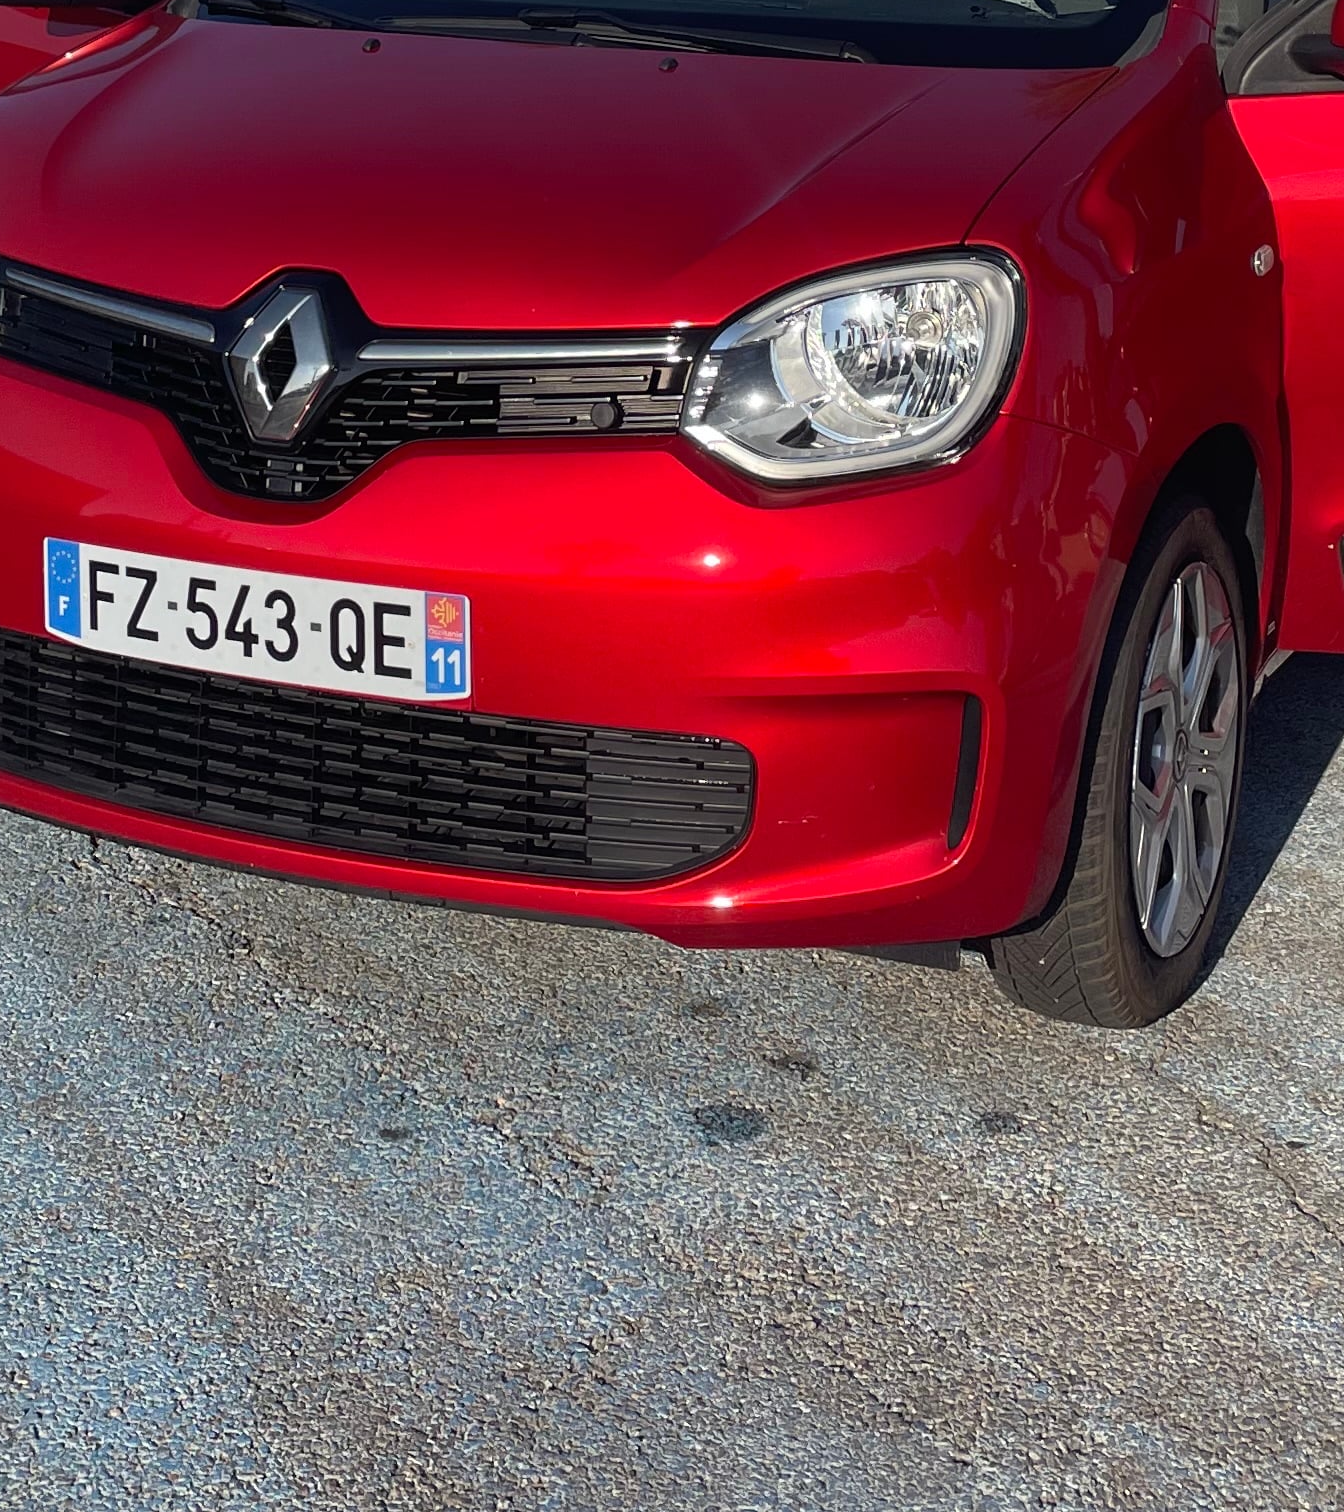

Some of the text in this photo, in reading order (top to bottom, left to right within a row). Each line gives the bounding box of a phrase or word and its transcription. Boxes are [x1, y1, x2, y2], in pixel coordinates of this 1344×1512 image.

[59, 595, 70, 617] F
[88, 559, 413, 680] FZ-543-QE
[431, 647, 461, 686] 11
